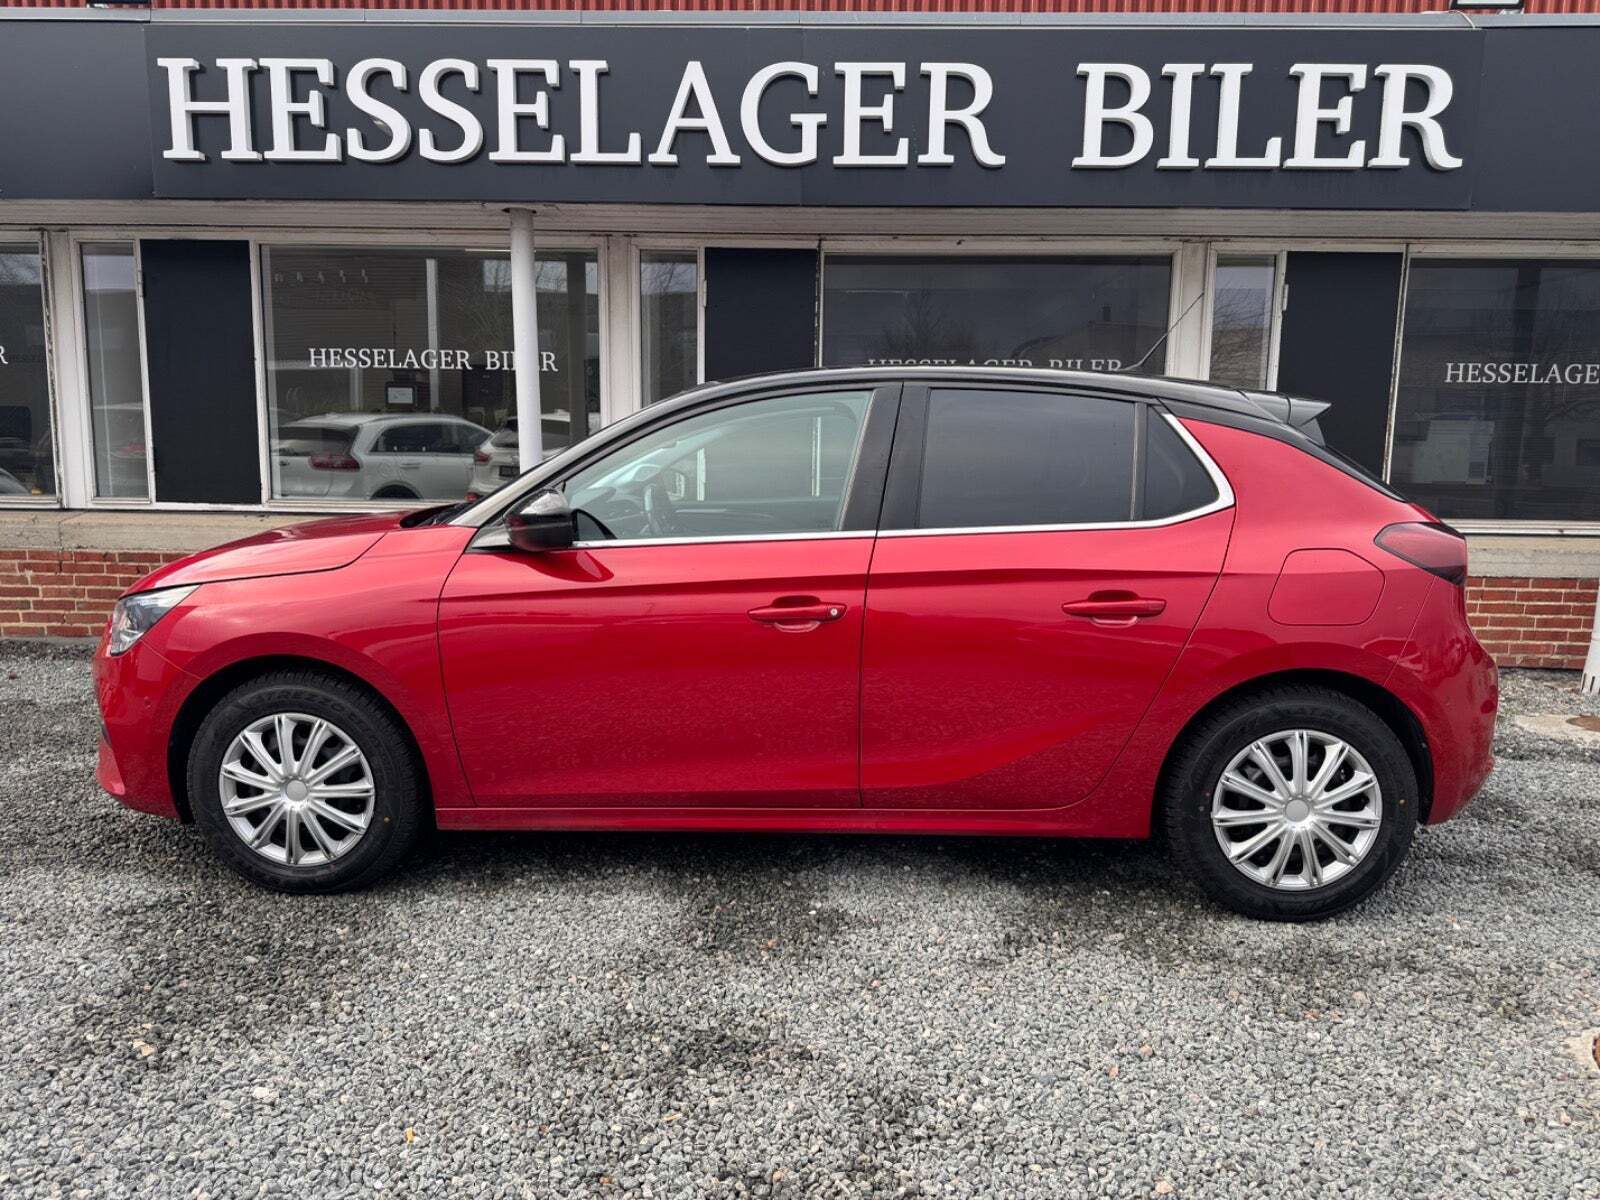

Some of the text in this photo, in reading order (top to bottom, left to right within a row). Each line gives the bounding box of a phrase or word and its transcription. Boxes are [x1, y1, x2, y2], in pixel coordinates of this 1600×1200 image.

[157, 57, 1464, 172] HESSELAGER BILER
[308, 348, 559, 372] HESSELAGER BIR
[1444, 362, 1600, 384] HESSELAGE
